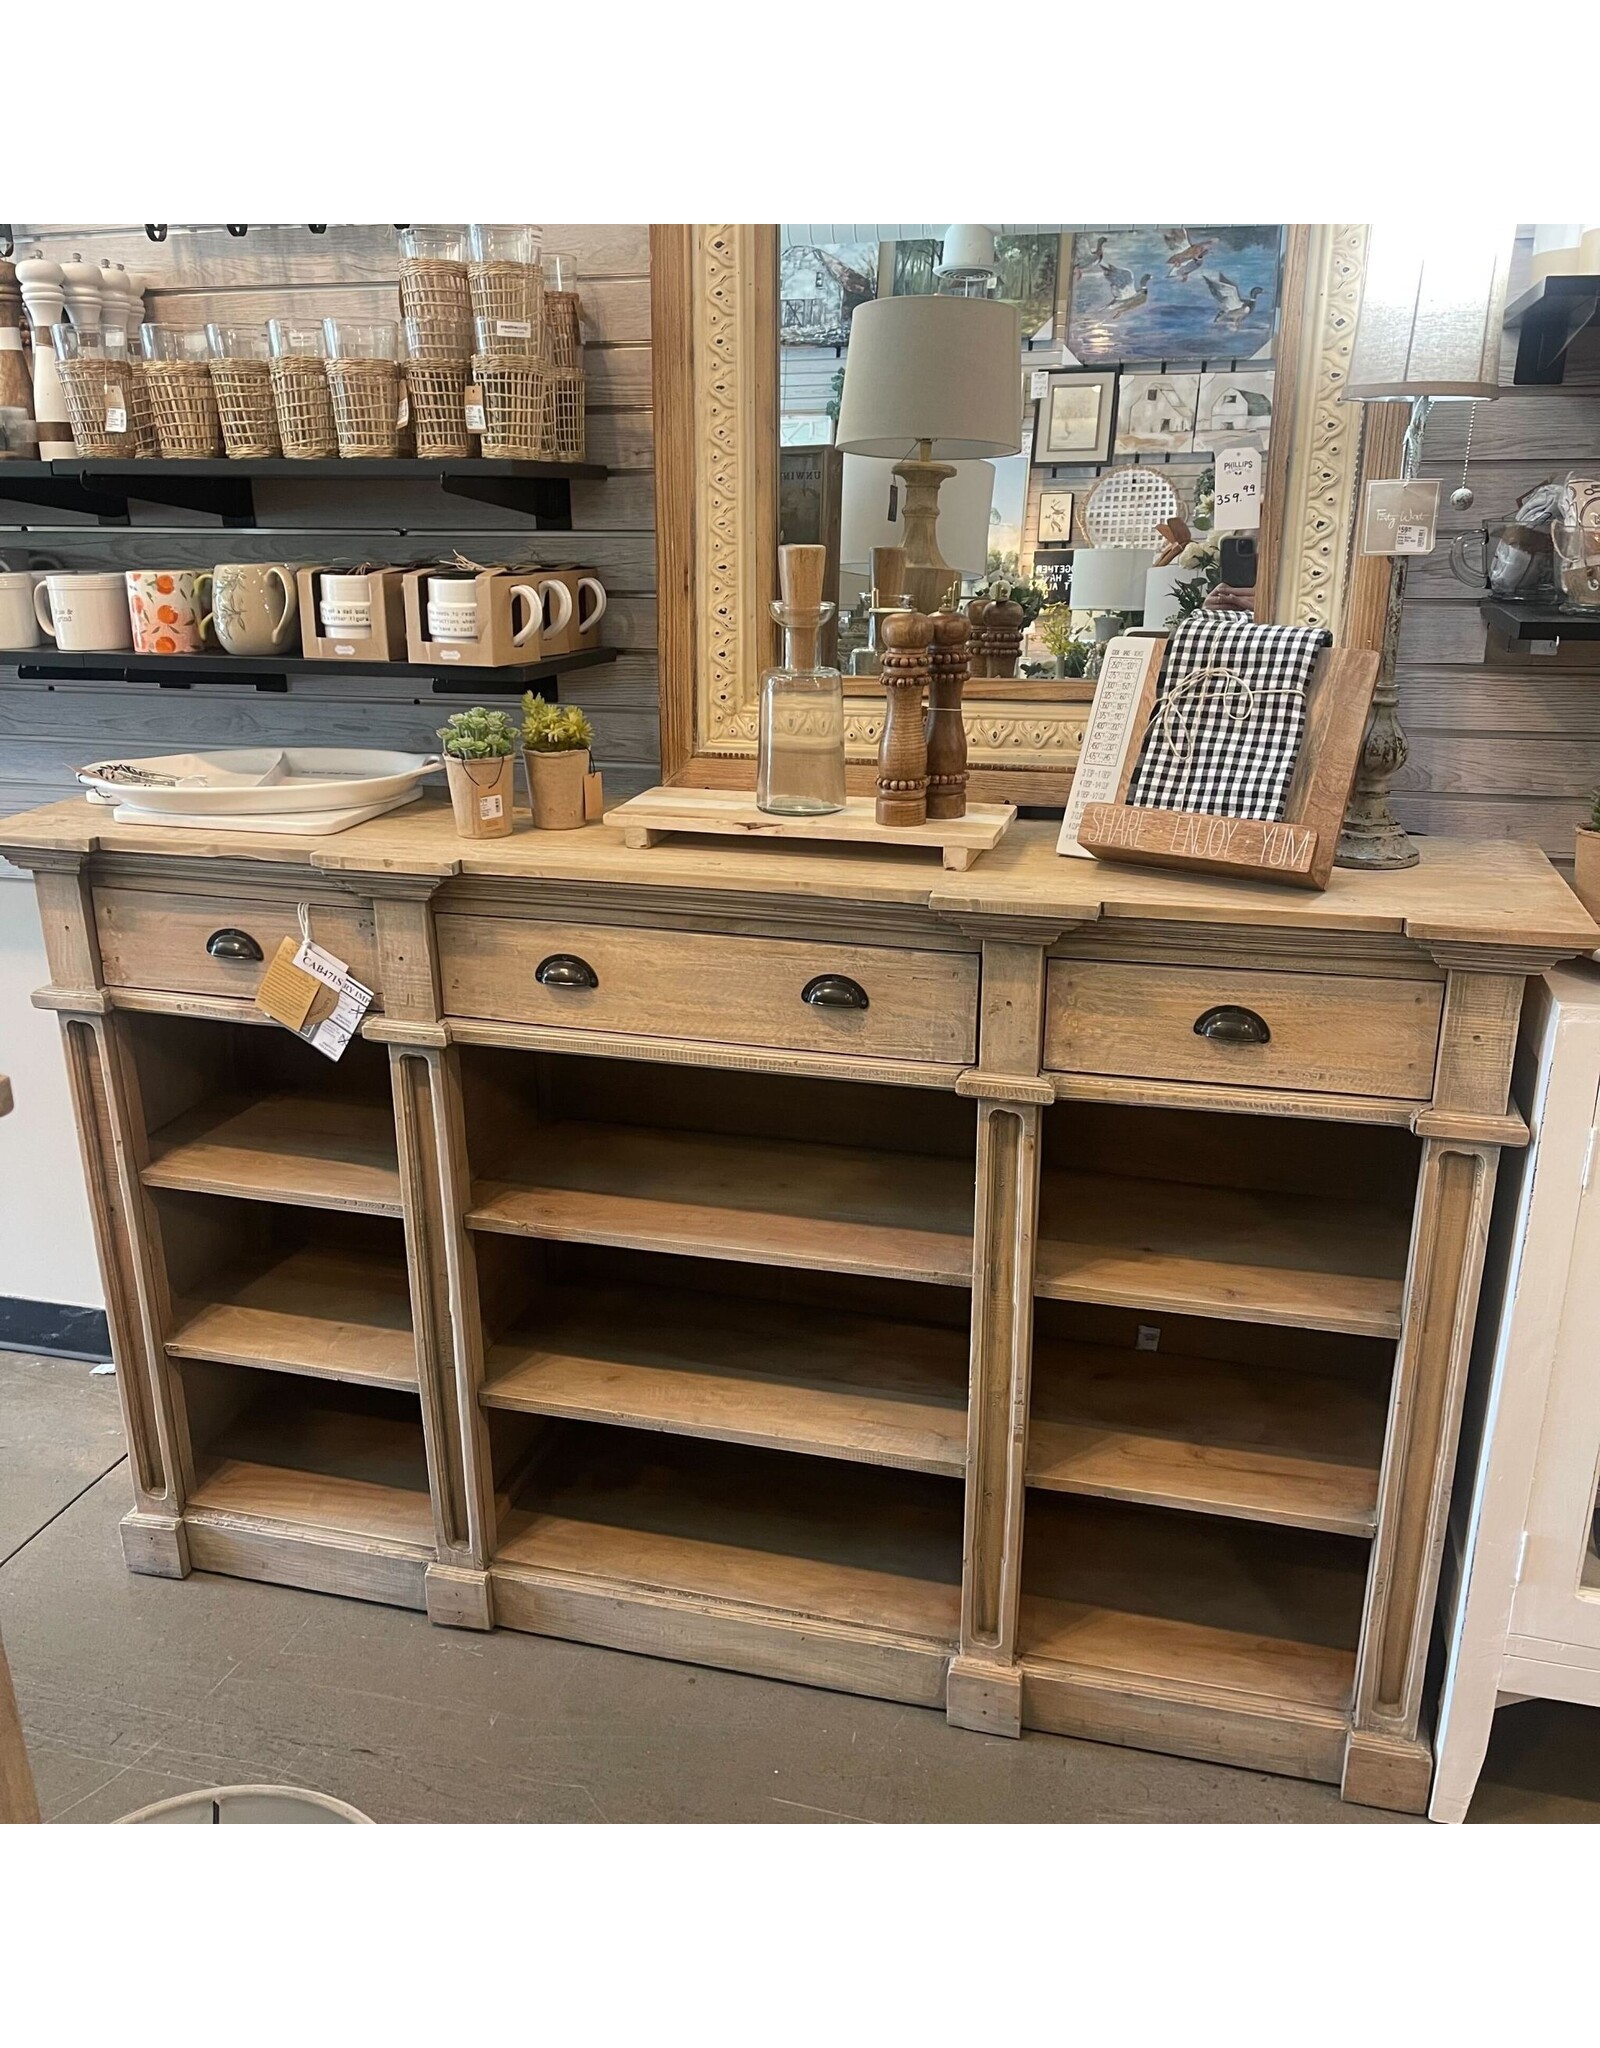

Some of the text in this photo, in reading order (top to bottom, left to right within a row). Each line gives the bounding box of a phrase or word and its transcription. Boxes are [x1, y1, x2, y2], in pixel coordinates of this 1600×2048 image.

[1224, 461, 1253, 470] PHILLIPS
[1088, 806, 1311, 869] SHARE ENJOY YUM
[302, 955, 343, 987] CAB471S
